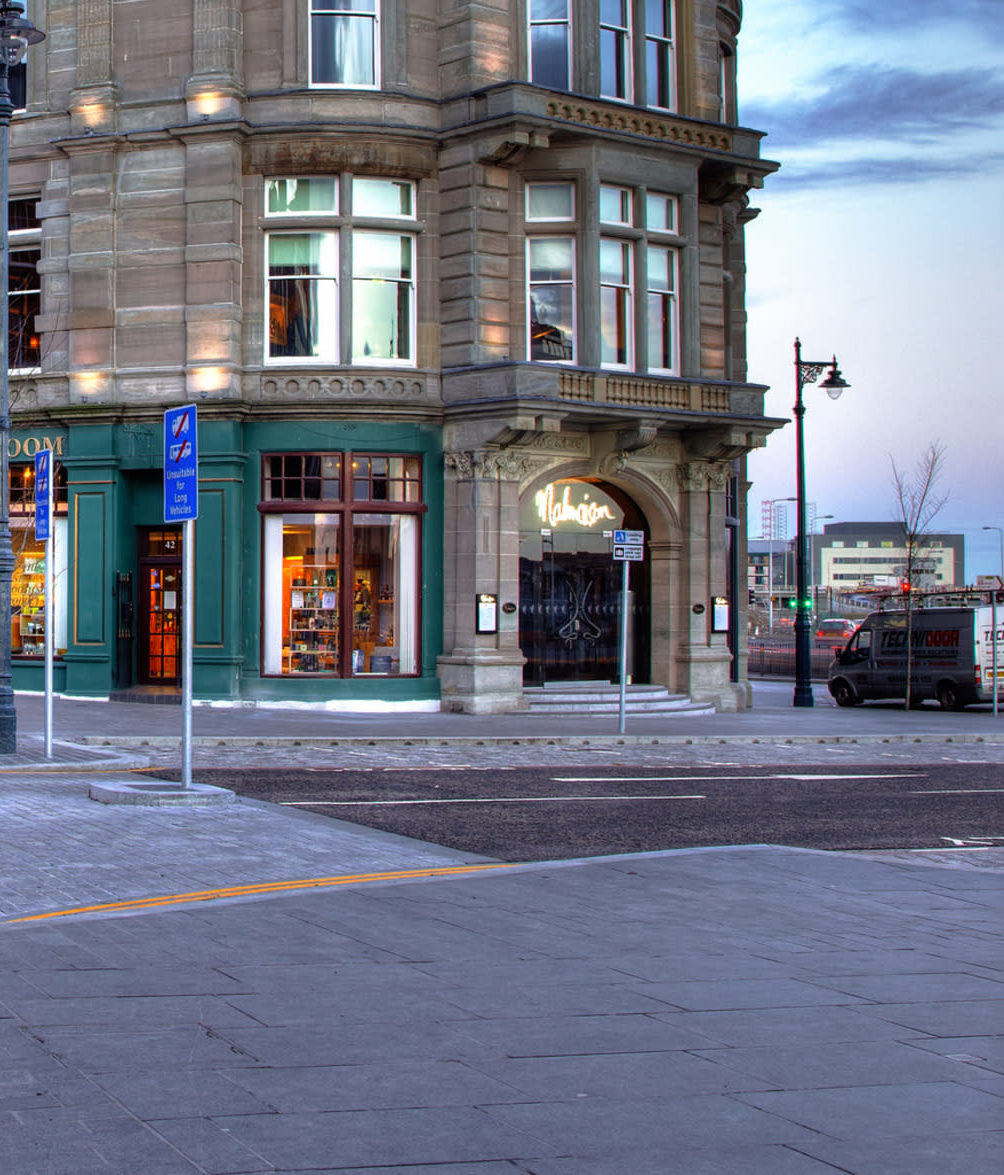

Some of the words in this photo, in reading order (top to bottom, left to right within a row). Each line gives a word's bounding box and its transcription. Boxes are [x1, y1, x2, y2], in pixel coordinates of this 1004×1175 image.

[166, 467, 196, 480] Unsuitable
[176, 480, 185, 491] for
[174, 493, 188, 504] Long
[169, 504, 192, 515] Vehicles
[535, 484, 616, 527] Malmaison
[164, 540, 176, 549] 42
